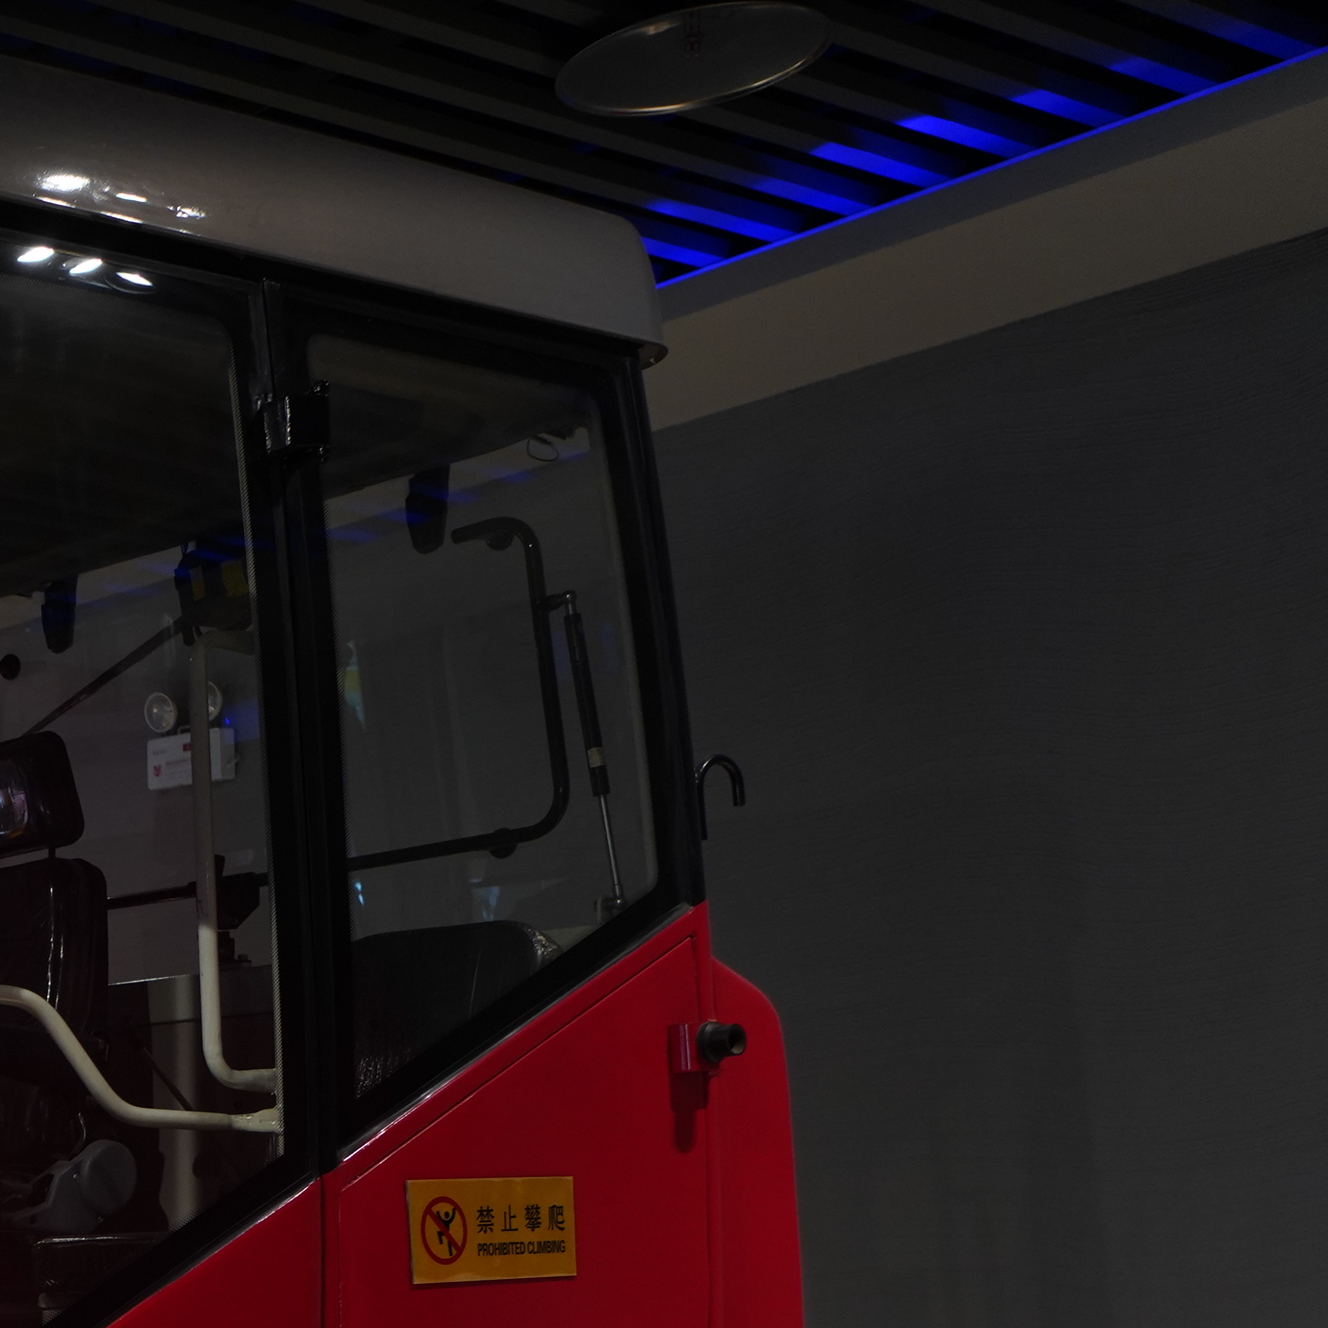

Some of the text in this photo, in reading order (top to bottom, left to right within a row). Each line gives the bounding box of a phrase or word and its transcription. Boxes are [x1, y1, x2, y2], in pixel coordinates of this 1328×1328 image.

[476, 1205, 565, 1233] 禁止攀爬
[477, 1239, 566, 1257] PROHIBITED CLIMBING
